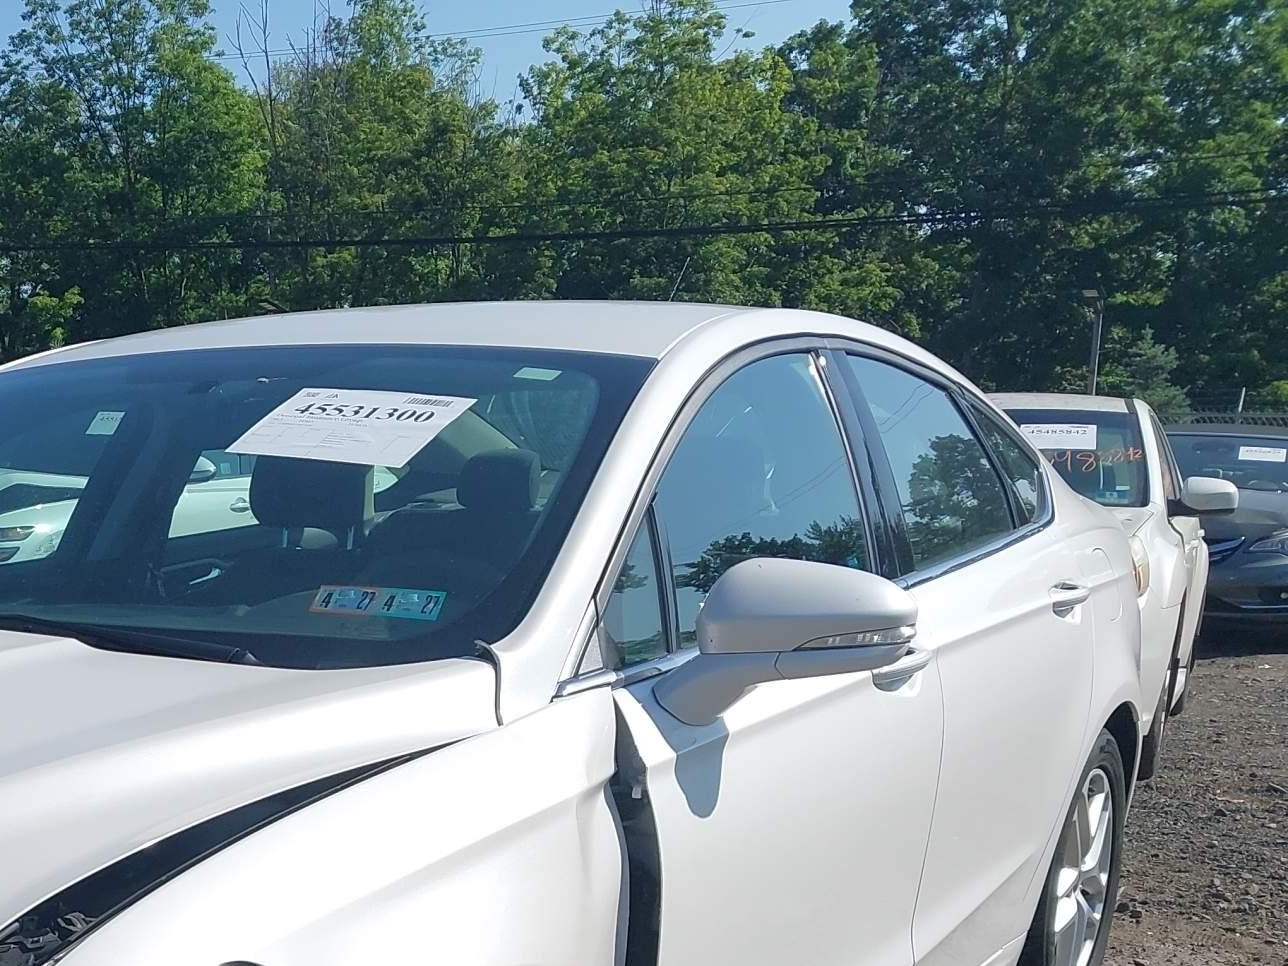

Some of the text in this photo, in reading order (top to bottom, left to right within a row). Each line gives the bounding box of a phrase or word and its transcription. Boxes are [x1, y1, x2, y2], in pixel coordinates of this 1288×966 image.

[294, 402, 436, 424] 45531300
[320, 591, 376, 611] 4 27
[382, 595, 441, 616] 4 27
